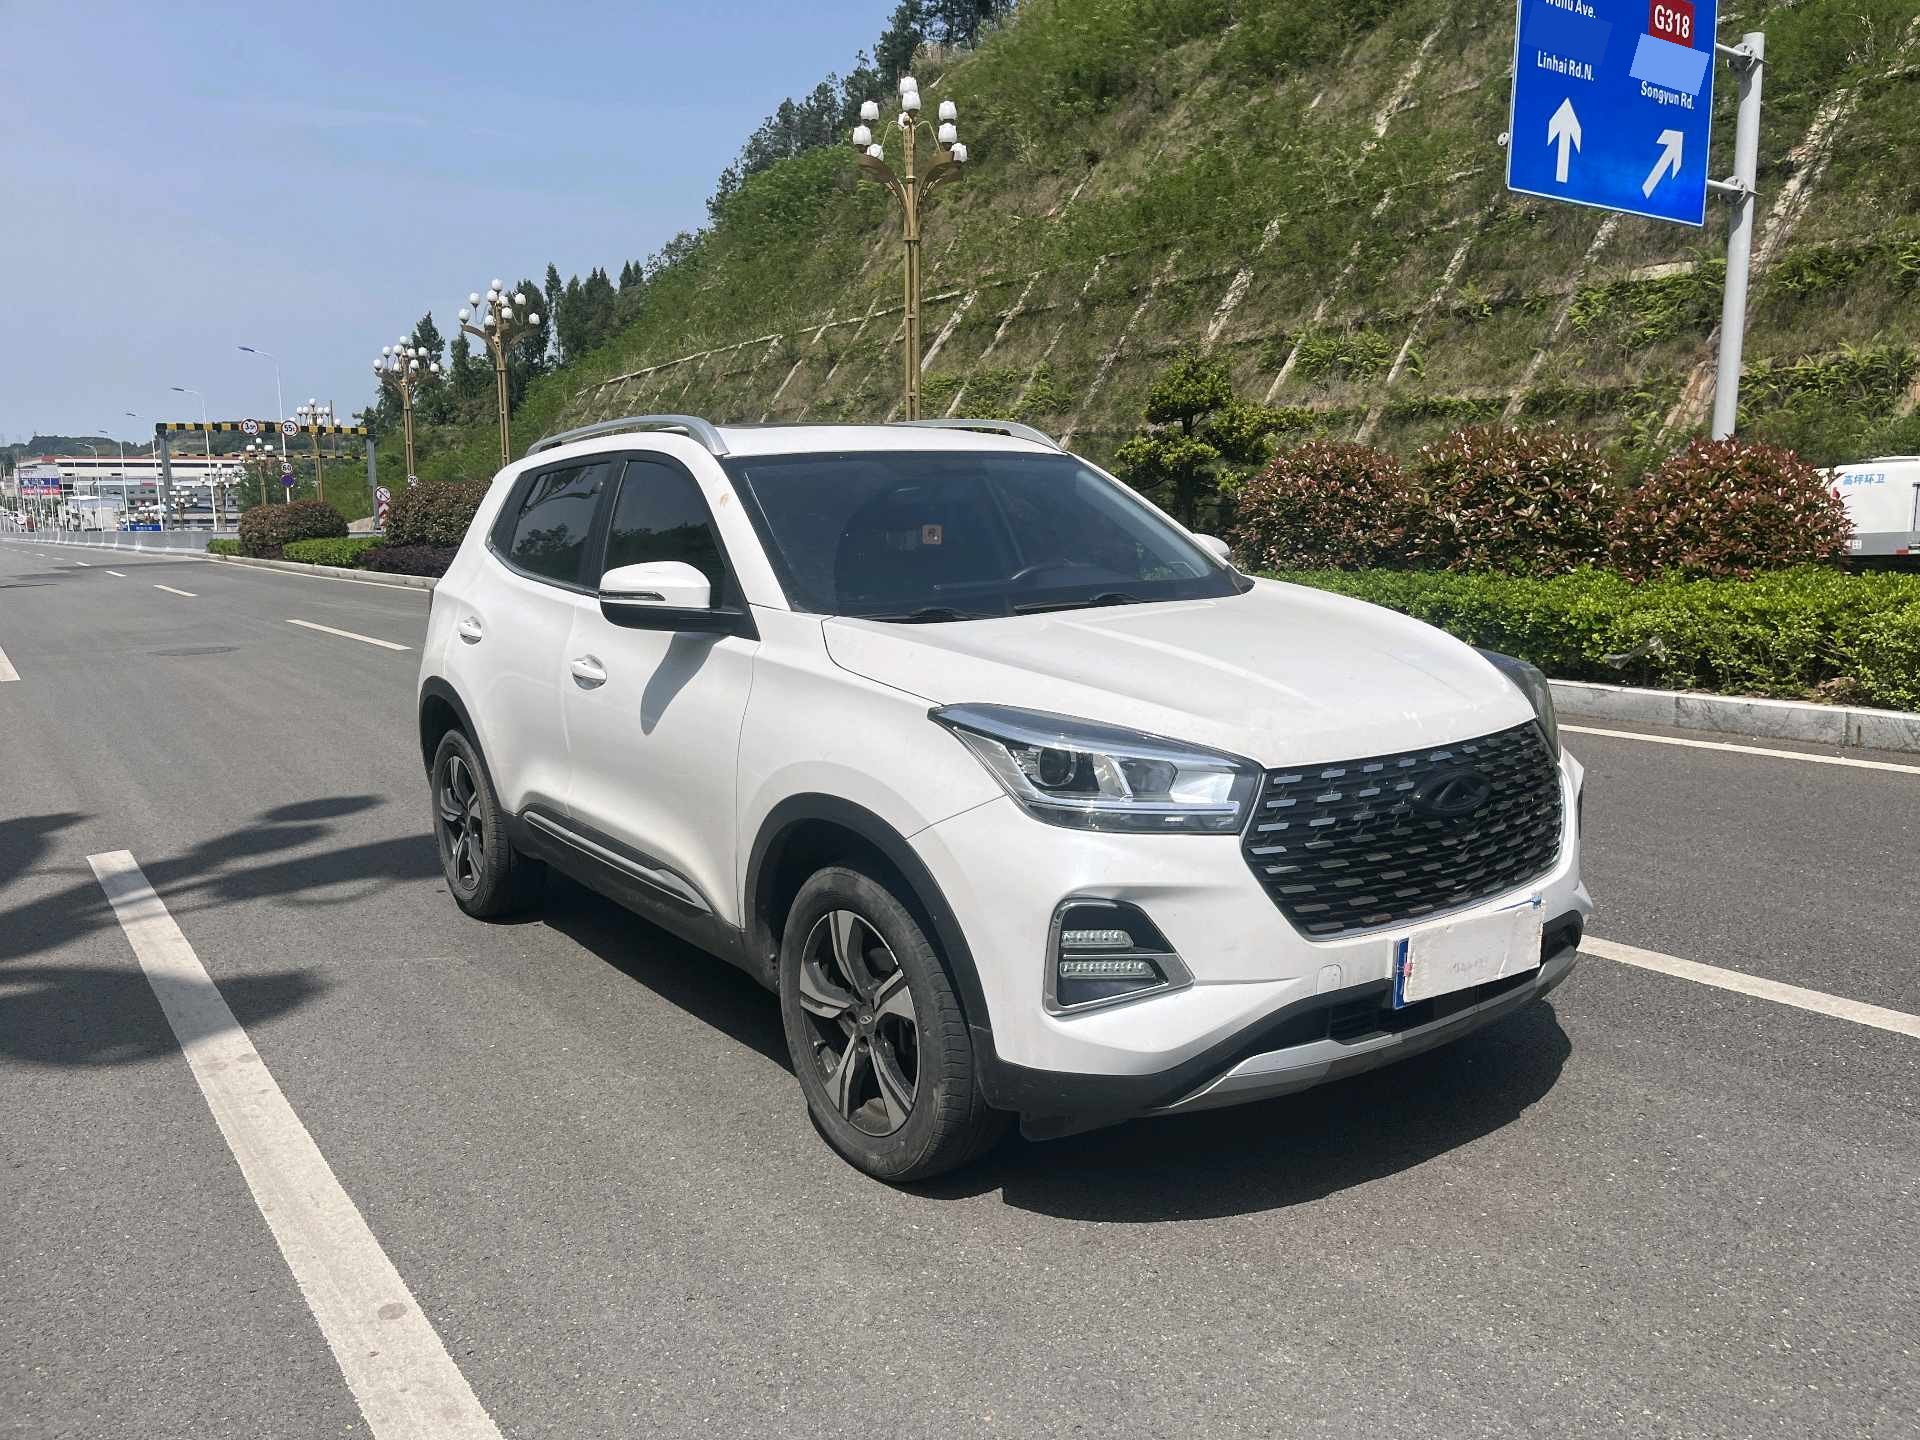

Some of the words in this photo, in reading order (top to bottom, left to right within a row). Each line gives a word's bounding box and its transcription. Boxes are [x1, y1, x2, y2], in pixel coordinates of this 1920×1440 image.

[1575, 0, 1596, 18] Ave.
[1654, 4, 1690, 39] G318
[1537, 50, 1568, 75] Linhai
[1641, 80, 1680, 105] Songyun
[1680, 92, 1695, 110] Rd.
